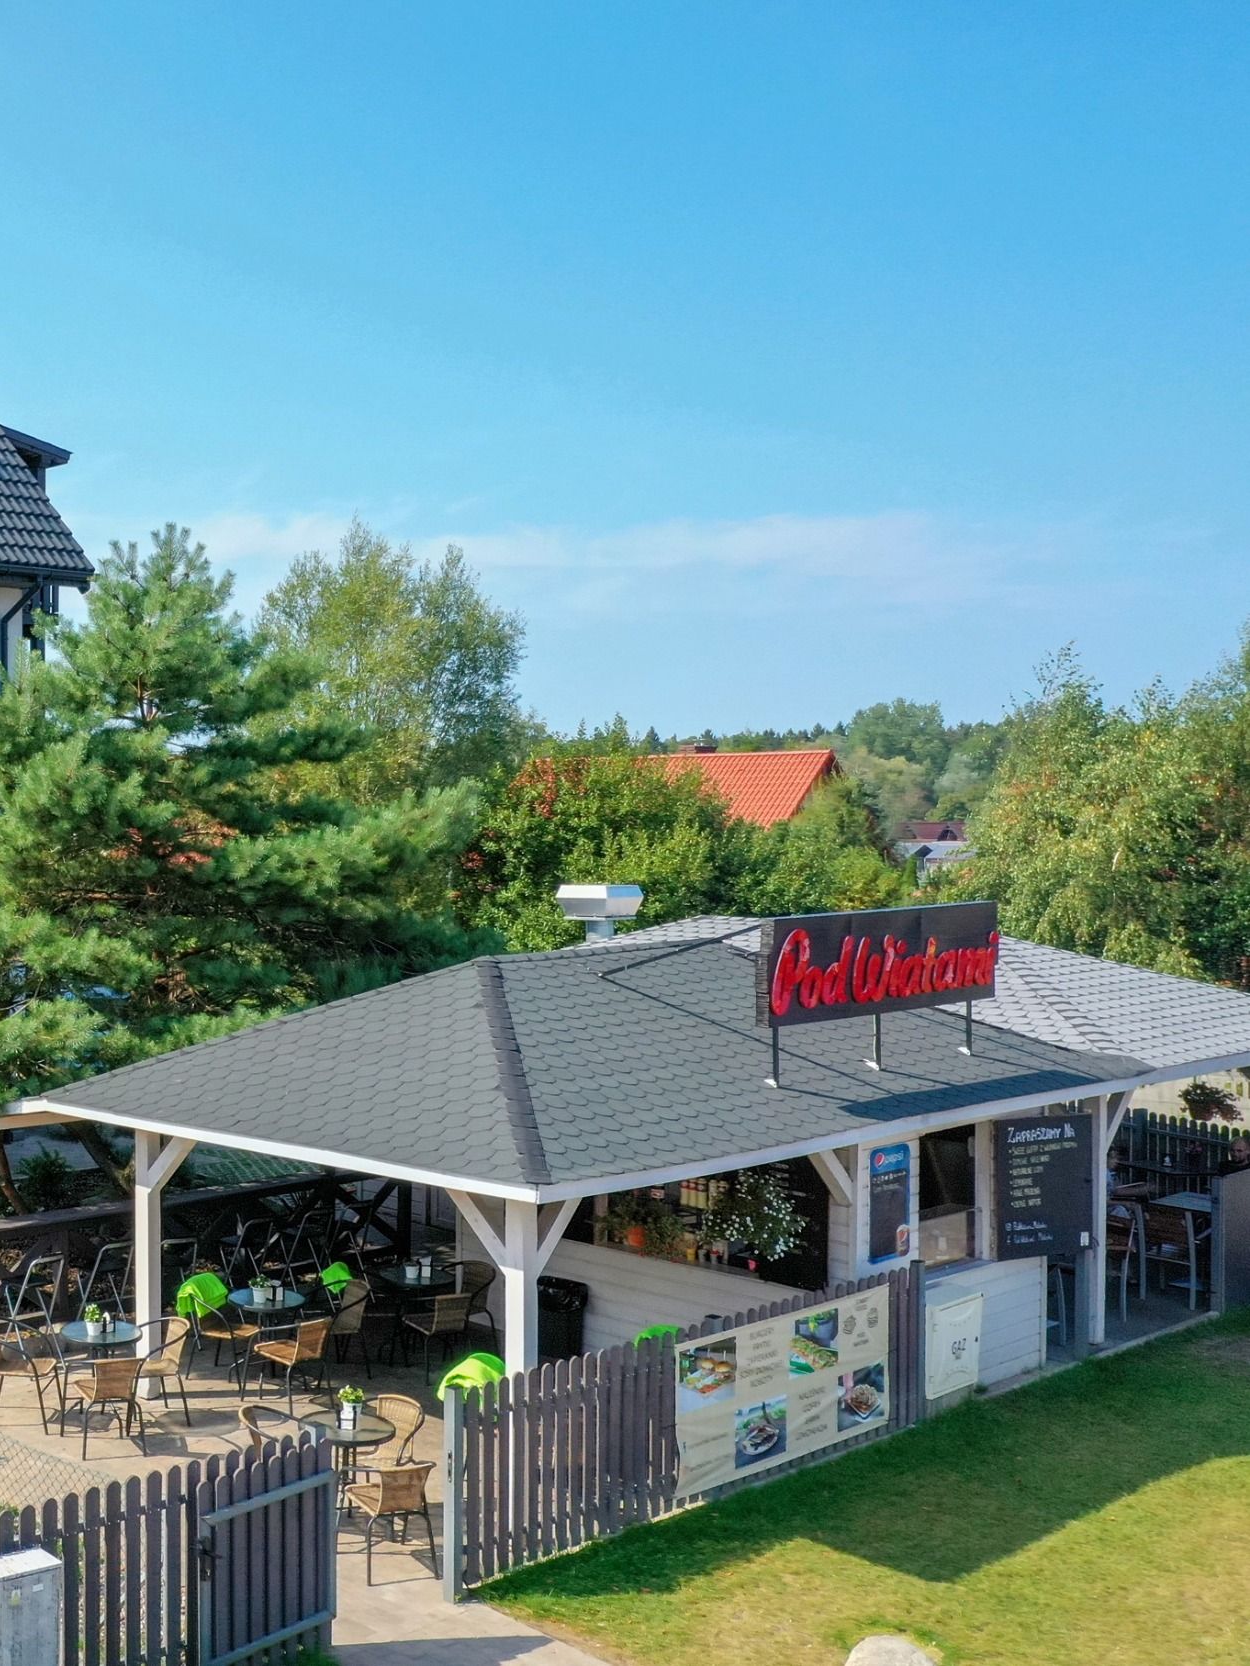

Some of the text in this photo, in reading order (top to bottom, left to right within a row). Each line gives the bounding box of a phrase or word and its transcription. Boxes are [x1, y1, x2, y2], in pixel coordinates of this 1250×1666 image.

[769, 927, 1000, 1017] Pod Wiatami
[951, 1337, 967, 1355] GAZ
